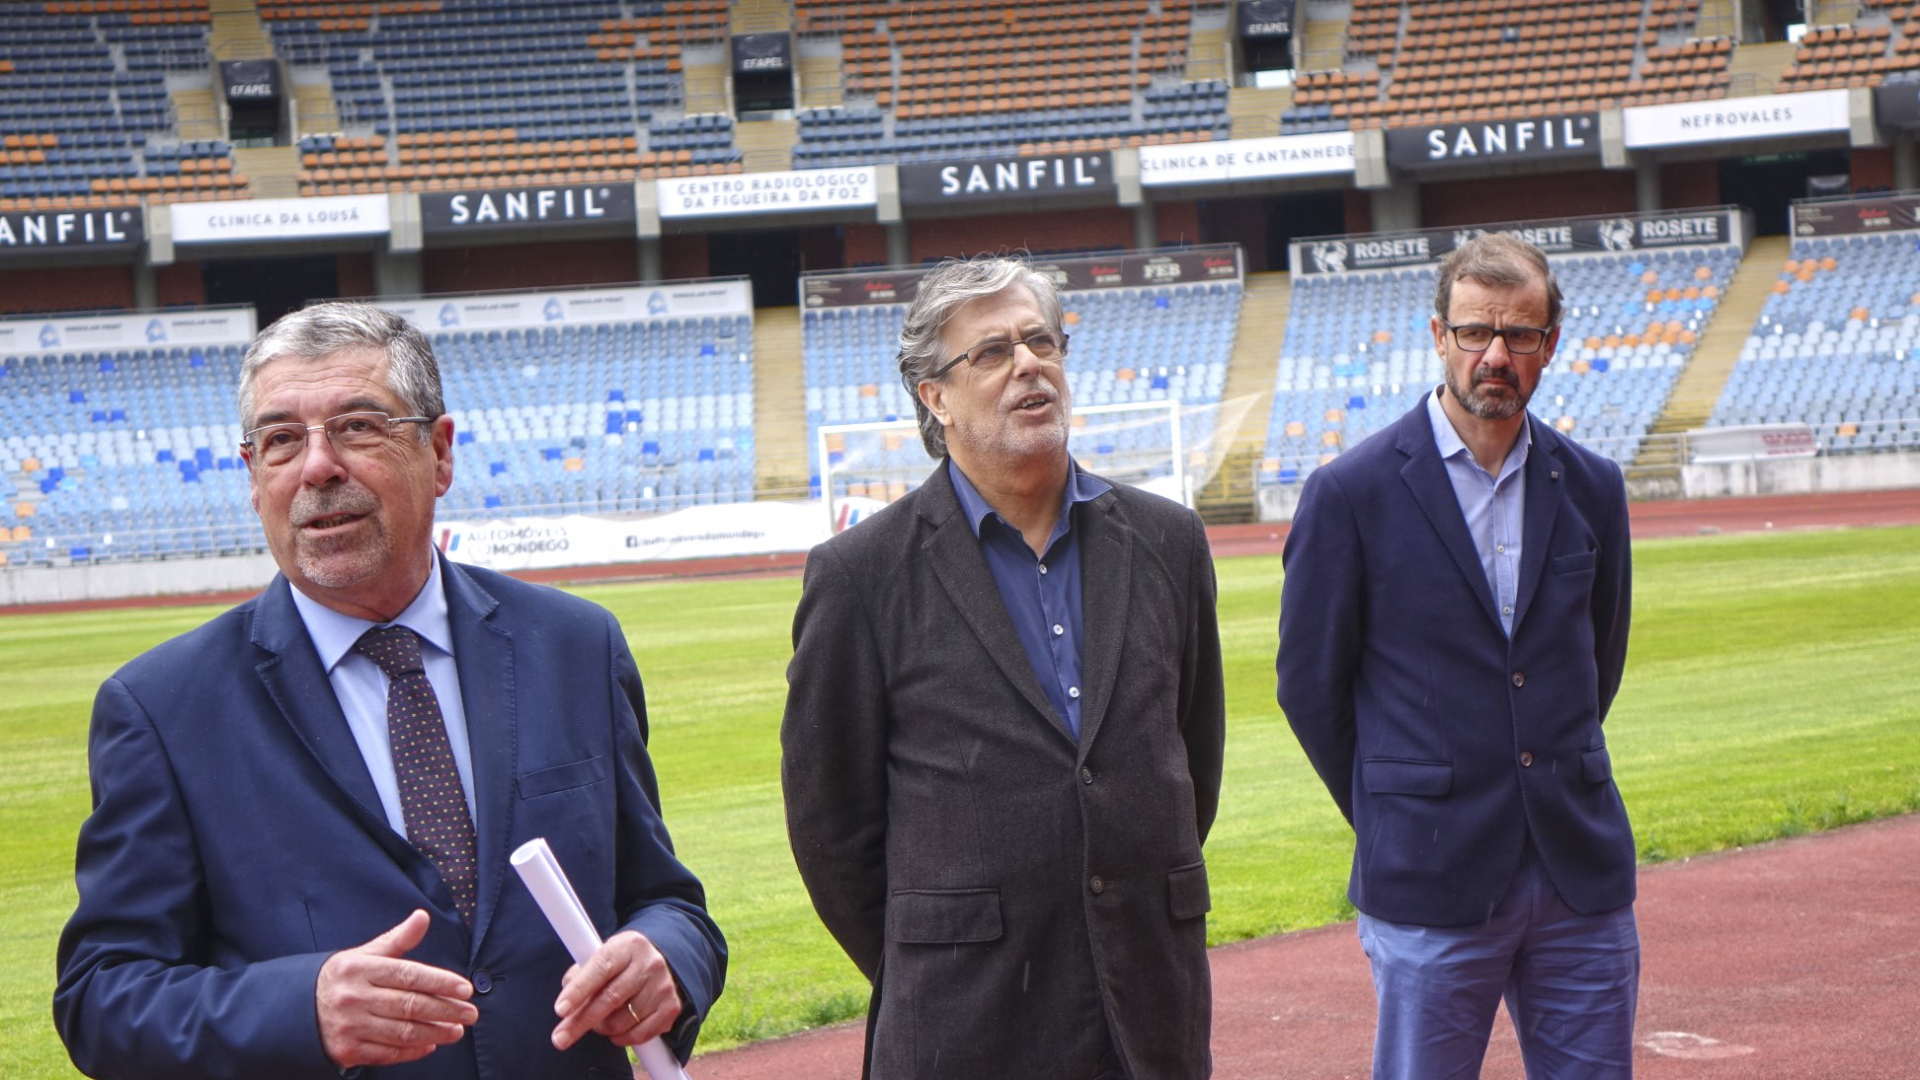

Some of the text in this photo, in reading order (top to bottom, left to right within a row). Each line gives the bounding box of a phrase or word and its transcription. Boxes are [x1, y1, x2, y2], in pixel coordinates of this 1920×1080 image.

[1680, 108, 1793, 128] NEFROVALES
[1216, 153, 1236, 167] DE
[1244, 145, 1355, 165] CANTANHEDE
[677, 180, 744, 196] CENTRO
[683, 187, 860, 209] DA FIGUEIRA DA FOZ
[279, 212, 300, 225] DA
[307, 207, 360, 223] LOUSÃ
[1510, 226, 1572, 245] OSETE
[1641, 216, 1718, 237] ROSETE
[1354, 237, 1429, 258] ROSETE
